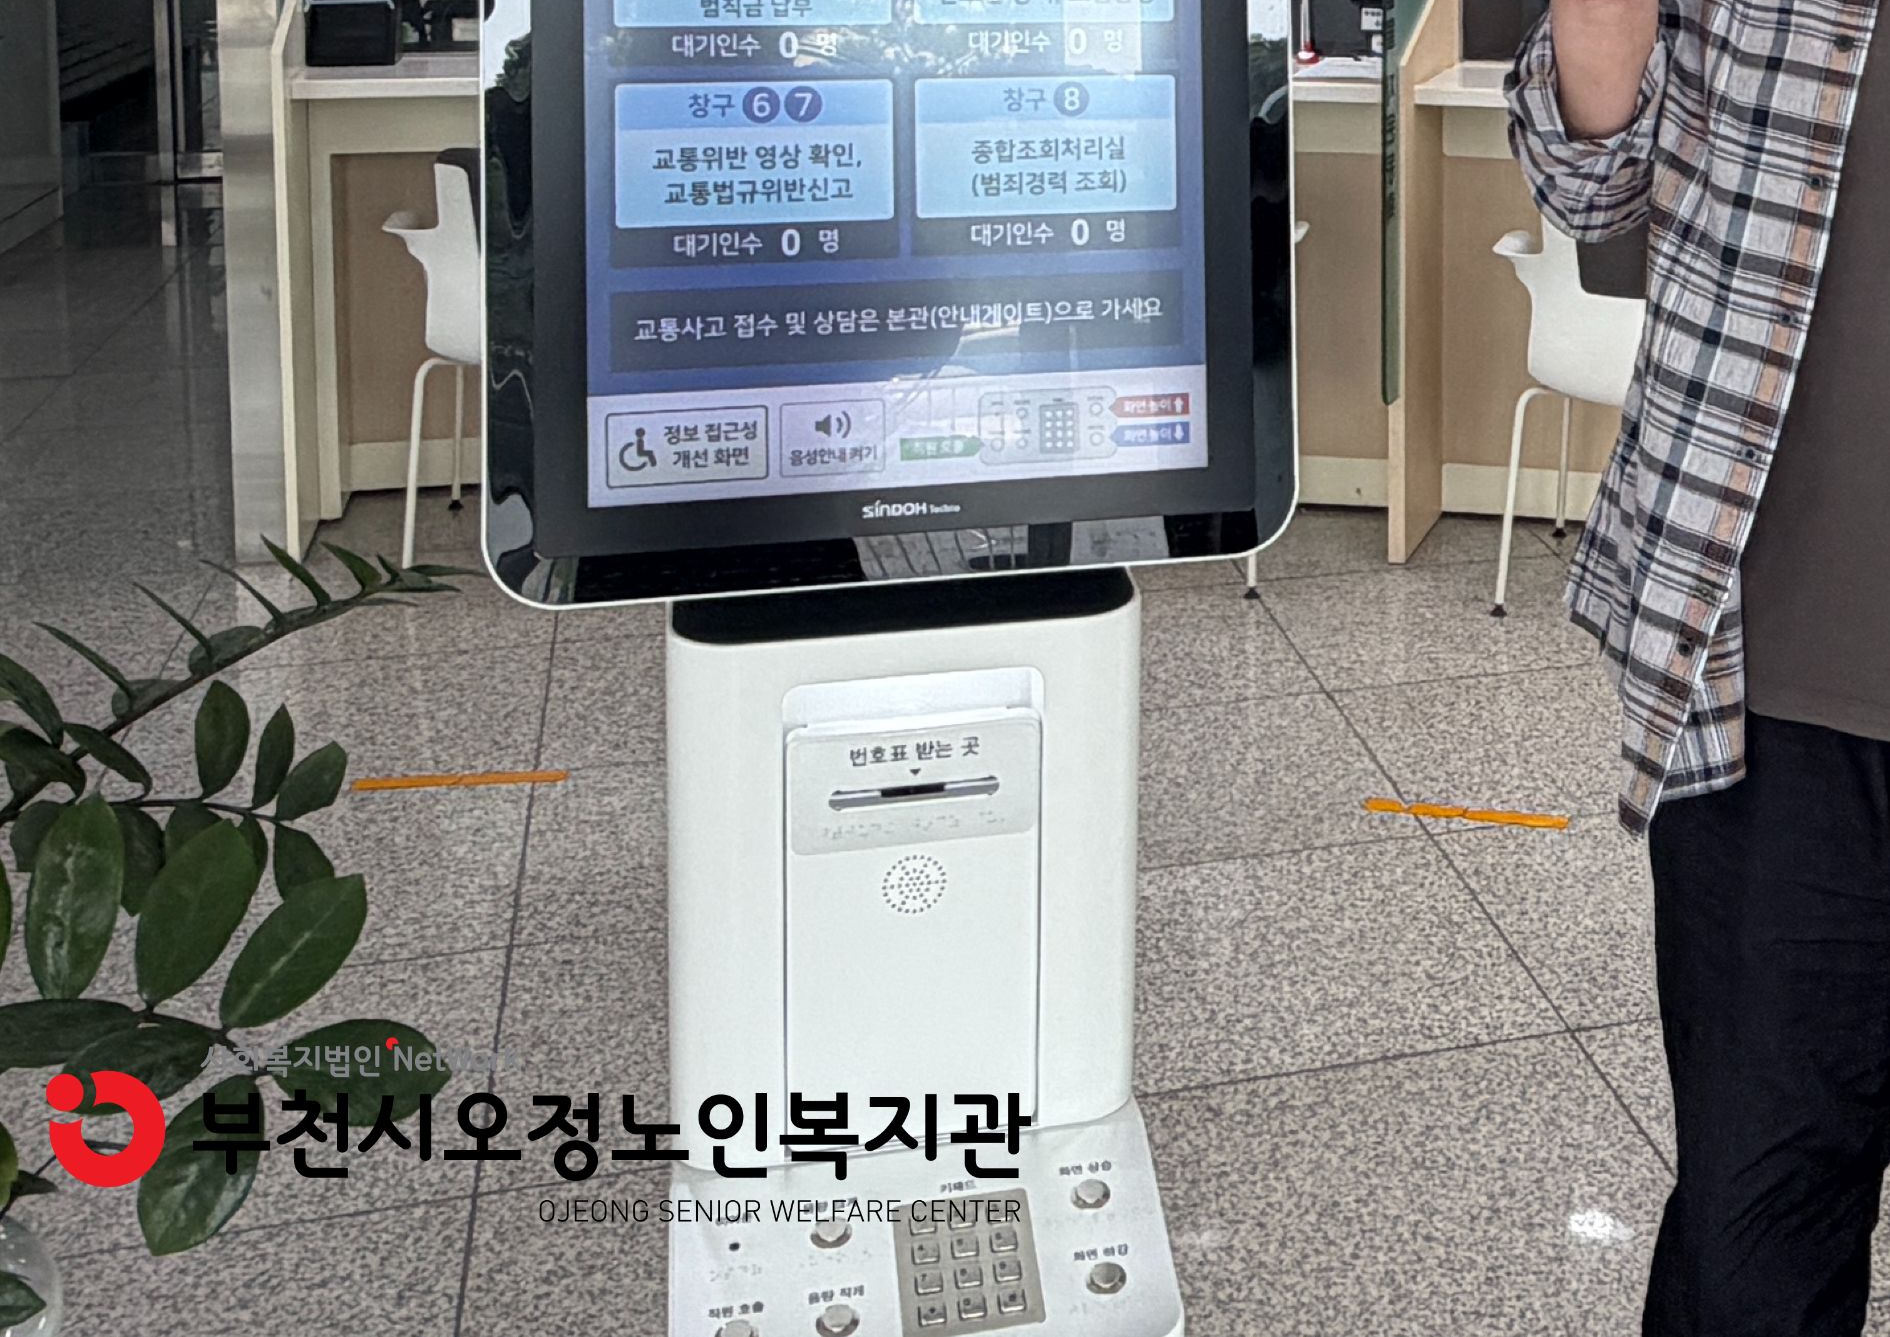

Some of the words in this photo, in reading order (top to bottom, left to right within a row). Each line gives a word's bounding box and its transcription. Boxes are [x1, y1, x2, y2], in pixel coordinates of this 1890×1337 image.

[672, 33, 761, 57] 대기인수
[780, 31, 798, 58] 0
[968, 31, 1051, 55] 대기인수
[1068, 30, 1087, 55] 0
[688, 91, 735, 117] 창구
[1003, 88, 1048, 112] 창구
[652, 146, 748, 171] 교통위반
[755, 145, 802, 169] 영상
[808, 142, 863, 169] 확인,
[971, 136, 1125, 163] 종합조회처리실
[664, 178, 853, 206] 교통법규위반신고
[971, 170, 1069, 198] (범죄경력
[1075, 170, 1127, 195] 조회)
[673, 232, 763, 256] 대기인수
[782, 229, 800, 256] 0
[971, 222, 1054, 247] 대기인수
[1071, 218, 1090, 246] 0
[634, 315, 727, 342] 교통사고
[734, 312, 778, 338] 접수
[785, 310, 806, 335] 및
[814, 307, 880, 334] 상담은
[886, 299, 1095, 332] 본관(안내게이트)으로
[1101, 298, 1163, 319] 가세요
[664, 426, 700, 444] 정보
[705, 422, 758, 443] 접근성
[673, 447, 709, 469] 개선
[714, 445, 749, 466] 화면
[849, 743, 908, 766] 번호표
[916, 741, 952, 760] 받는
[961, 737, 980, 757] 곳
